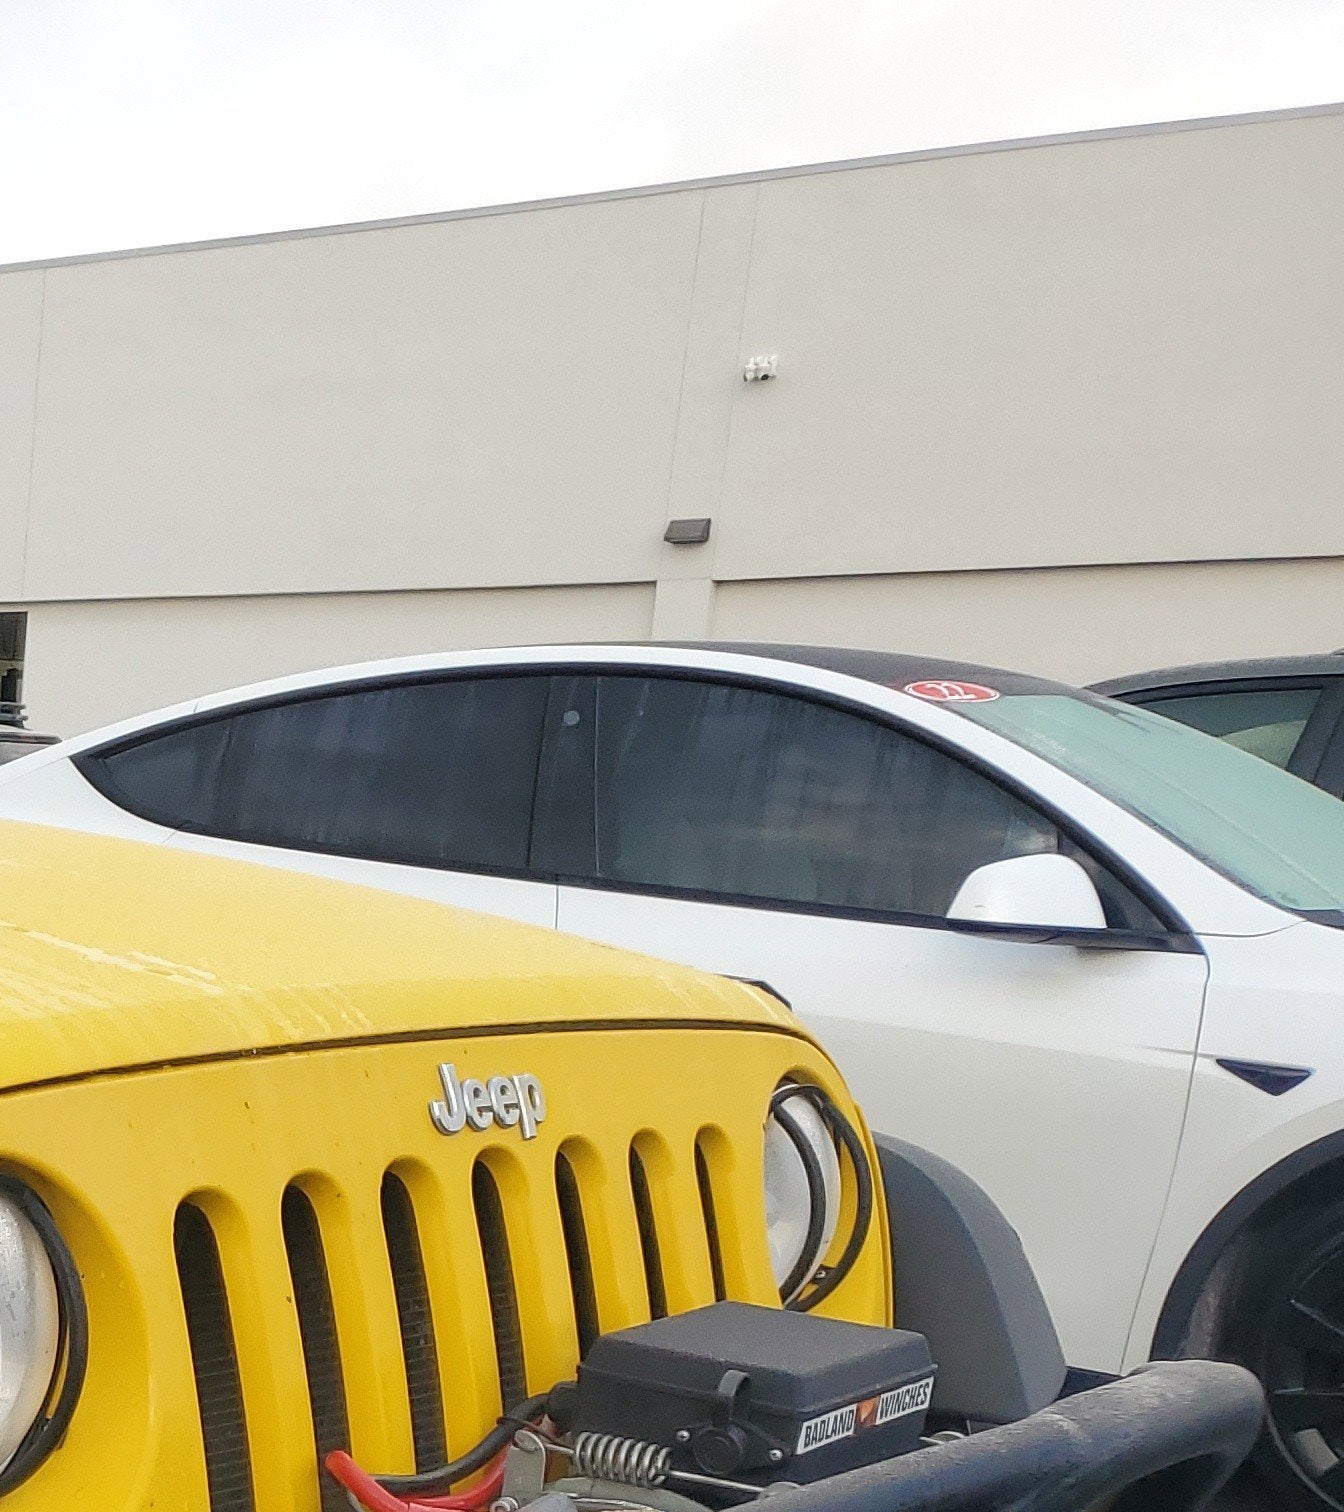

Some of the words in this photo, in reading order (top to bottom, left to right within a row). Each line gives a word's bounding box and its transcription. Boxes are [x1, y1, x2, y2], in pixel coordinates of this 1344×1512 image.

[428, 1062, 548, 1141] Jeep
[803, 1409, 856, 1449] BADLAND
[878, 1381, 931, 1421] WINCHES
